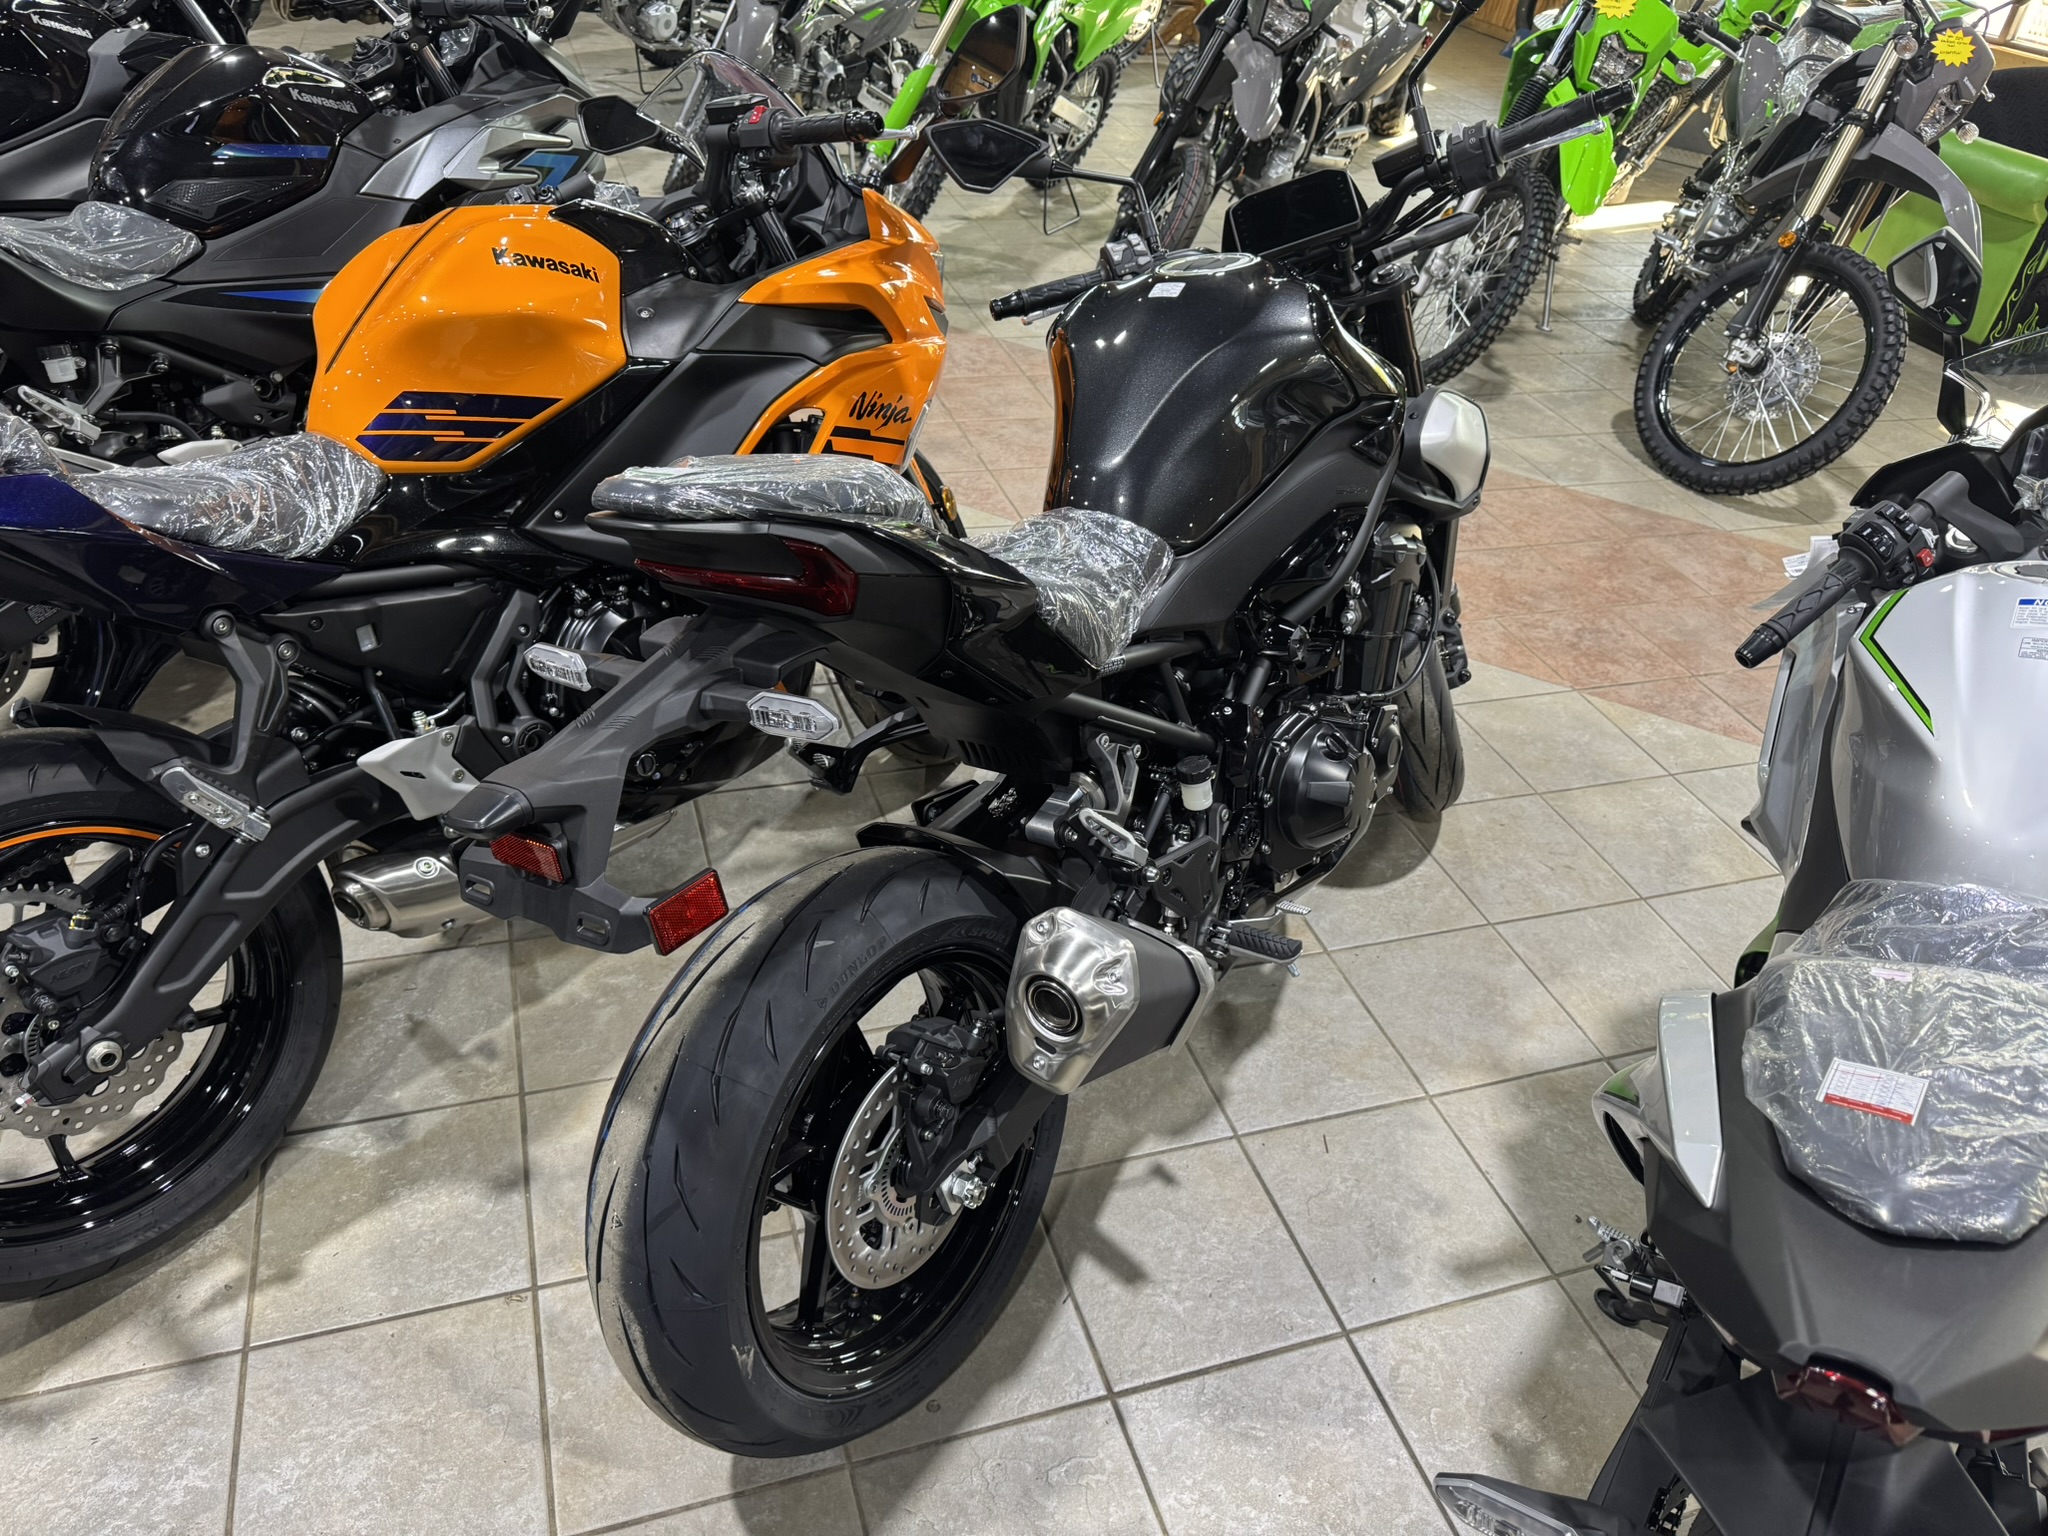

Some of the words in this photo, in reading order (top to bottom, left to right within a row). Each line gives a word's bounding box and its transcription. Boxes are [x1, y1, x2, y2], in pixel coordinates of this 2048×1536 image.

[30, 13, 93, 39] Kawasaki
[288, 87, 359, 114] Kawasaki
[491, 246, 600, 283] Kawasaki
[849, 390, 912, 431] Ninja
[828, 935, 888, 997] DUNLOP
